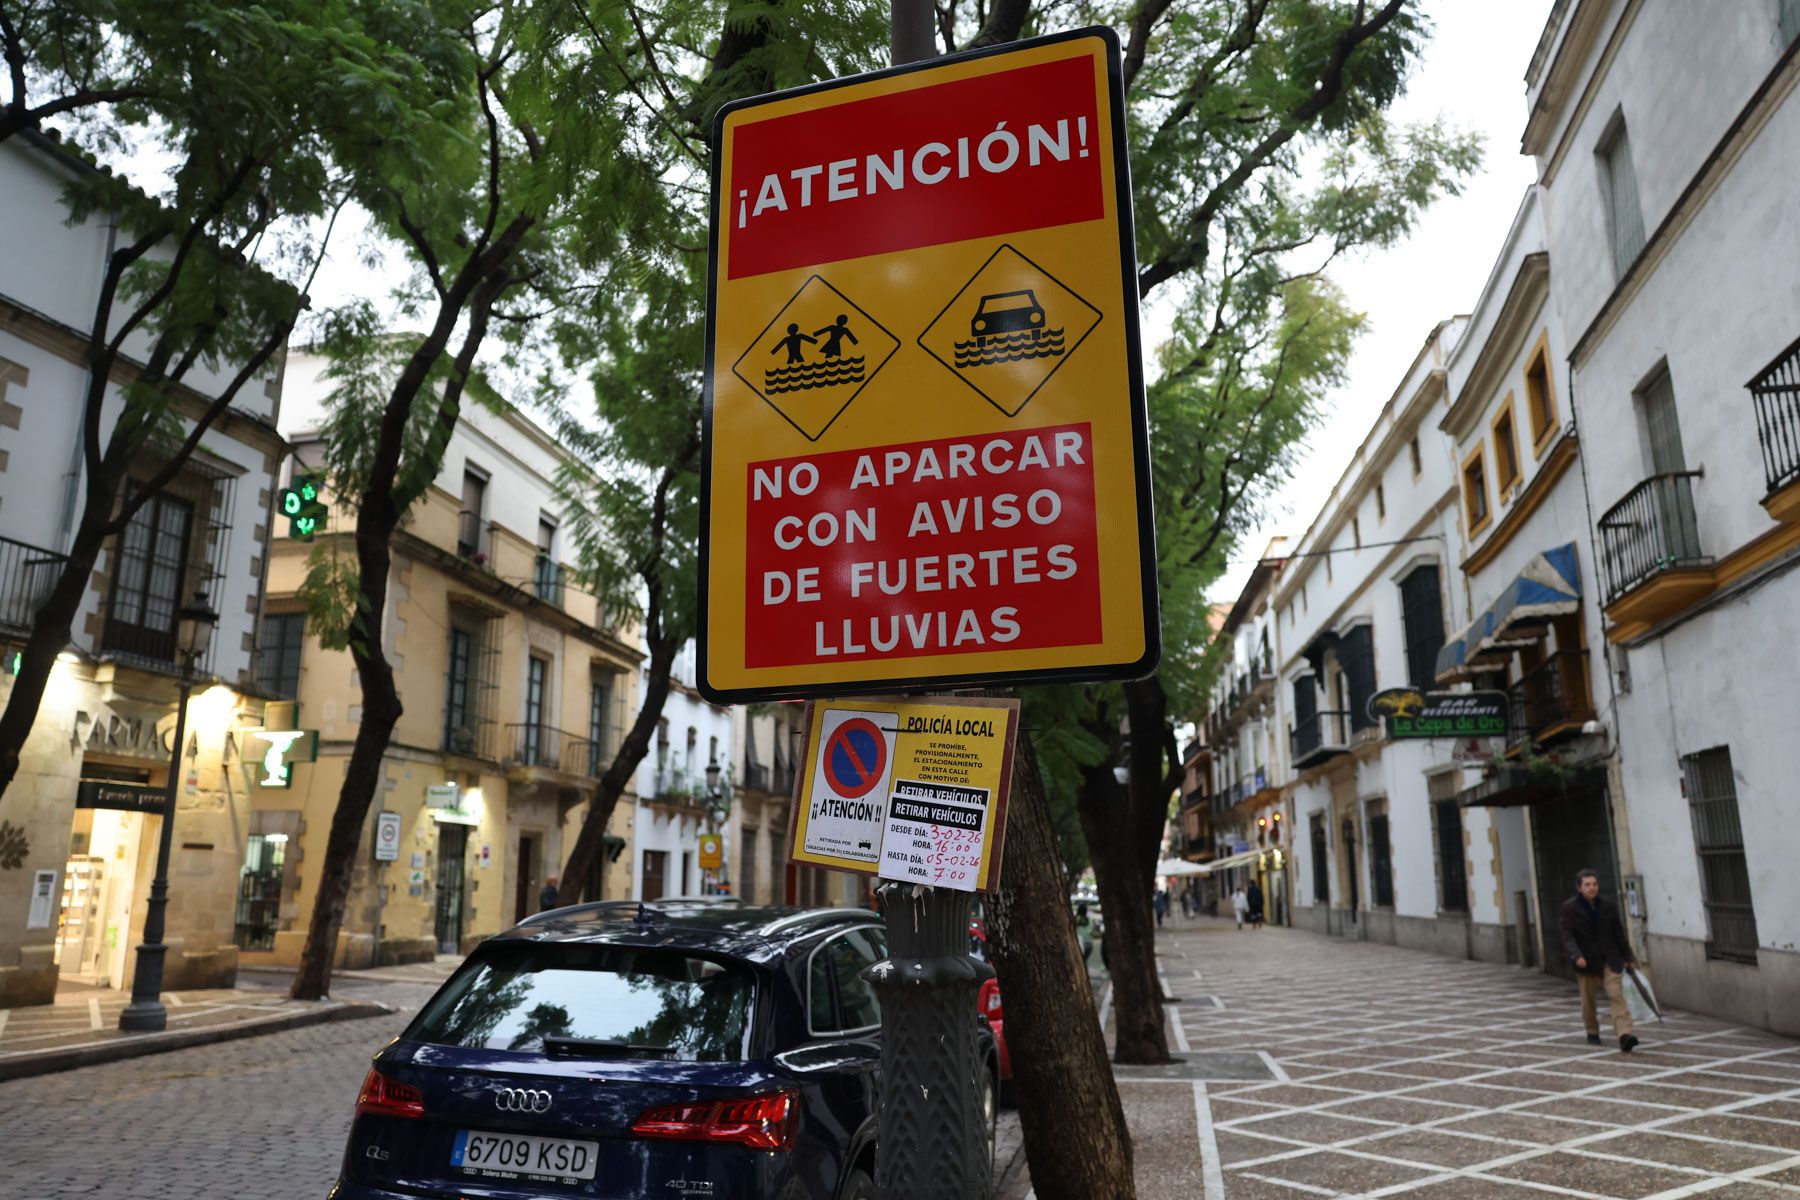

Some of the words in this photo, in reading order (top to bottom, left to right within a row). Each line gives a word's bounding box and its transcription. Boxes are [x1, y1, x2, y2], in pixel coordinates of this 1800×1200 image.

[738, 116, 1090, 228] ¡ATENCIÓN!
[753, 462, 820, 500] NO
[850, 431, 1086, 489] APARCAR
[773, 507, 877, 550] CON
[907, 489, 1062, 537] AVISO
[763, 566, 821, 605] DE
[851, 544, 1077, 597] FUERTES
[815, 606, 1021, 656] LLUVIAS
[1421, 706, 1499, 716] RESTAURANTE
[1440, 699, 1478, 708] BAR
[907, 714, 952, 734] POLICÍA
[956, 719, 994, 737] LOCAL
[922, 758, 983, 768] ESTACIONAMIENTO
[933, 775, 958, 783] MOTIVO
[900, 786, 934, 799] RETIRAR
[936, 789, 982, 805] VEHÍCULOS
[895, 803, 929, 818] RETIRAR
[931, 807, 977, 826] VEHÍCULOS
[891, 824, 912, 835] DESDE
[914, 827, 928, 837] DÍA:
[819, 837, 841, 845] RETIRADA
[912, 840, 933, 850] HORA:
[934, 840, 970, 853] 16:00
[887, 851, 908, 862] HASTA
[910, 854, 924, 865] DÍA:
[908, 867, 929, 877] HORA:
[934, 867, 965, 882] 7:00
[366, 1145, 389, 1160] Q5
[468, 1136, 530, 1167] 6709
[537, 1142, 587, 1173] KSD
[501, 1171, 518, 1179] Motor
[665, 1180, 686, 1189] 40
[690, 1181, 713, 1190] TDI
